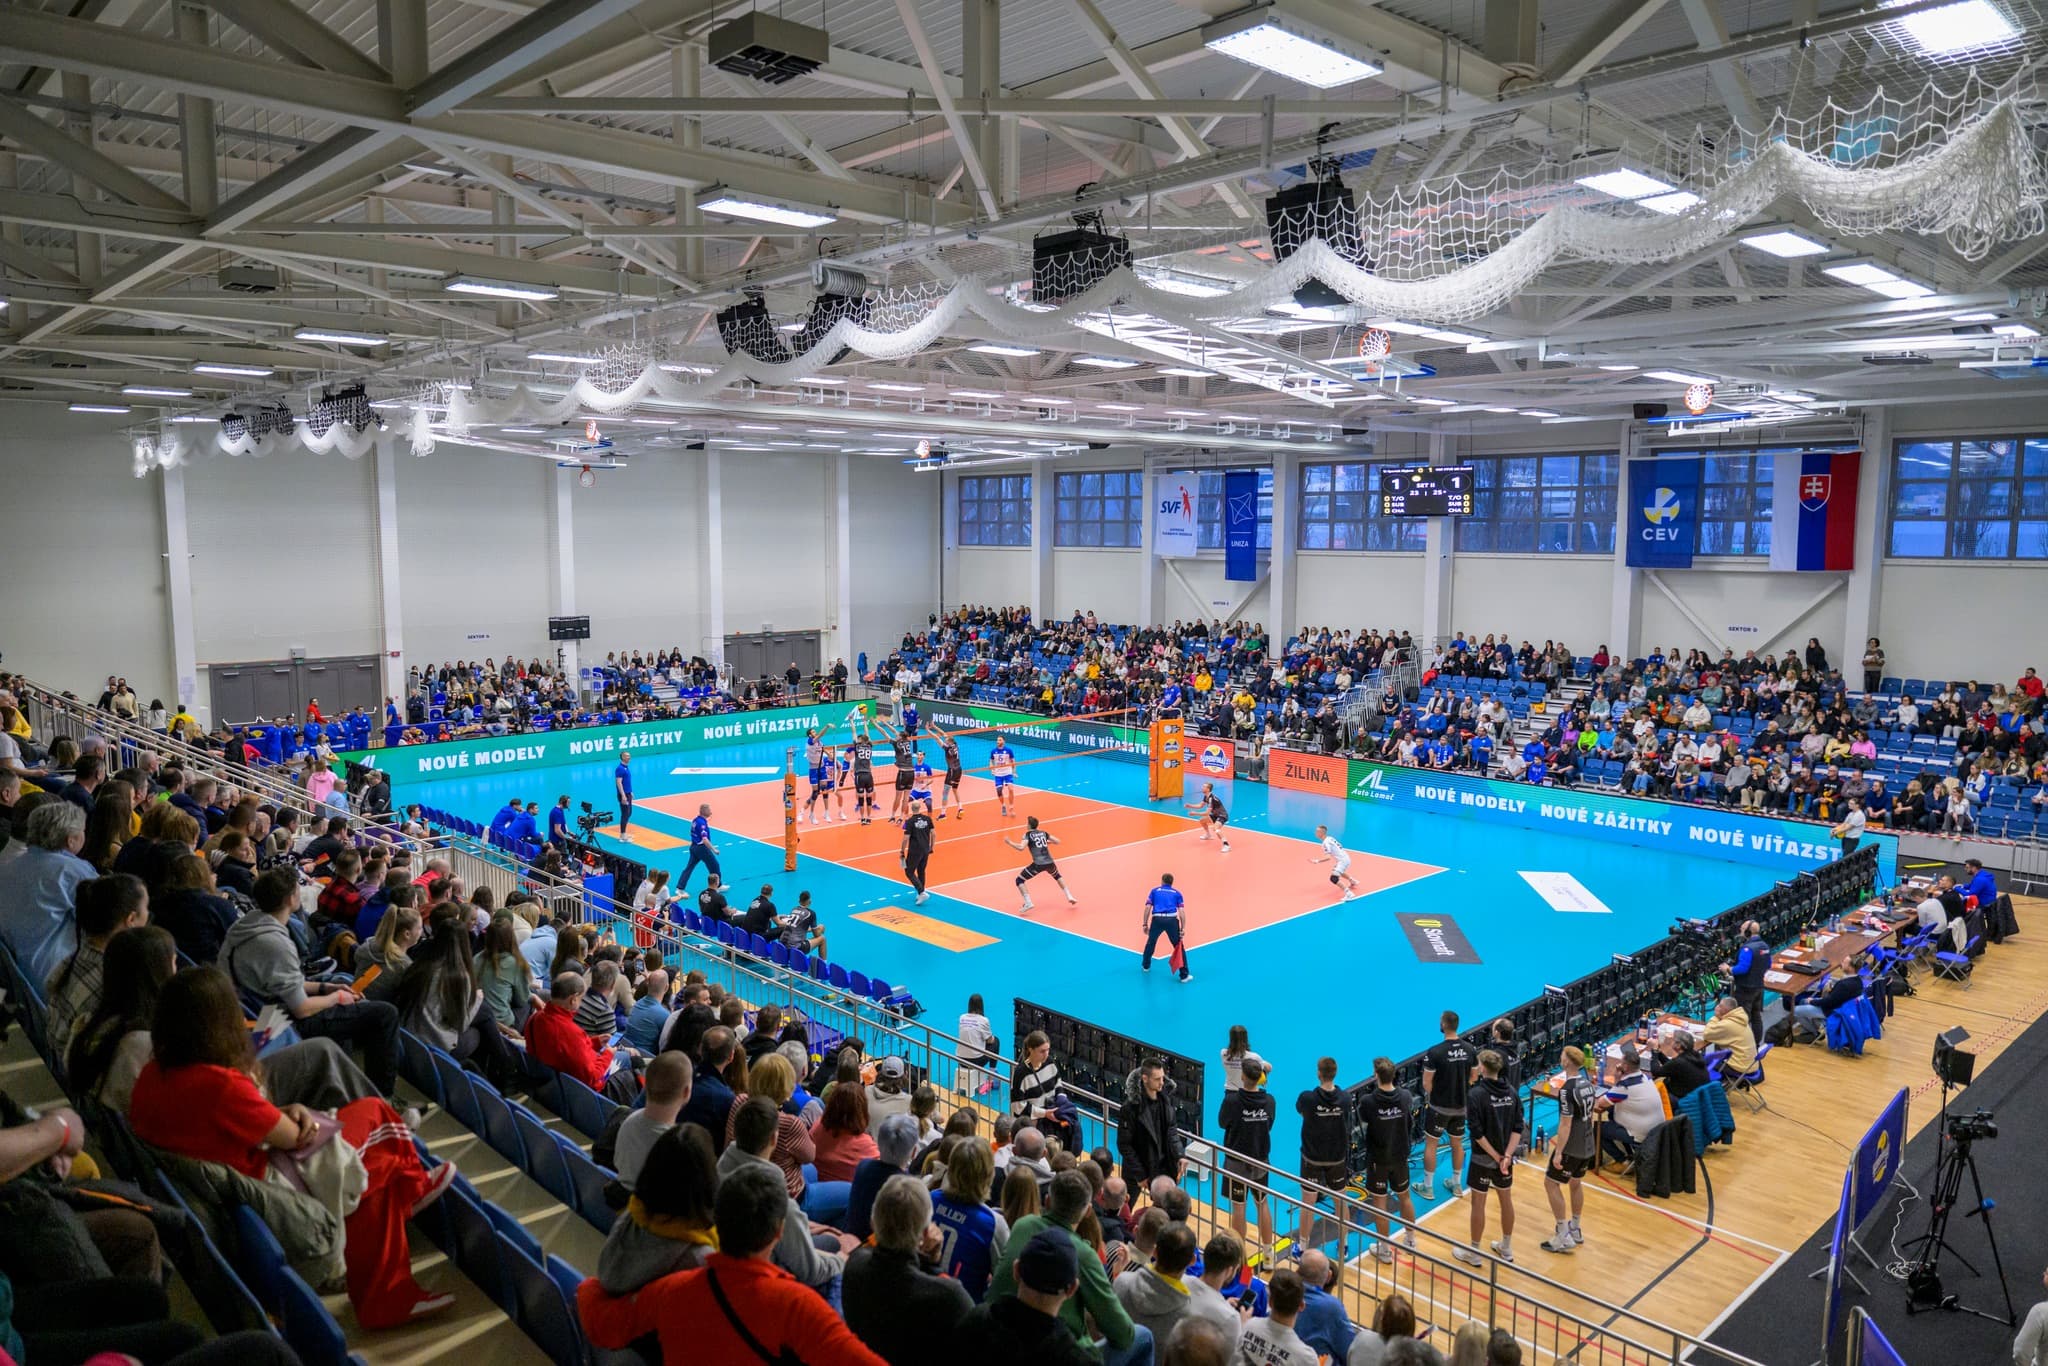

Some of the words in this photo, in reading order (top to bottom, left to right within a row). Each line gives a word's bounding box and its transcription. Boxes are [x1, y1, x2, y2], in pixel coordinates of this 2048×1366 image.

[1391, 478, 1400, 490] 1
[1451, 476, 1460, 489] 1
[1160, 501, 1181, 514] SVF
[1642, 528, 1679, 541] CEV
[704, 722, 742, 740] NOVÉ
[746, 714, 819, 734] VÍŤAZSTVÁ
[932, 713, 955, 725] NOVÉ
[956, 716, 990, 728] MODELY
[1022, 725, 1062, 741] ZÁŽITKY
[1069, 733, 1096, 747] NOVÉ
[570, 736, 614, 755] NOVÉ
[618, 730, 683, 749] ZÁŽITKY
[418, 751, 469, 772] NOVÉ
[474, 745, 546, 765] MODELY
[858, 748, 871, 760] 28
[1285, 761, 1330, 783] ŽILINA
[1351, 788, 1370, 797] Auto
[1415, 785, 1456, 803] NOVÉ
[1461, 791, 1527, 813] MODELY
[1540, 803, 1588, 823] NOVÉ
[1593, 811, 1673, 836] ZÁŽITKY
[1034, 836, 1047, 848] 20
[1689, 825, 1744, 847] NOVÉ
[1751, 834, 1843, 862] VÍŤAZST
[787, 913, 800, 928] 21
[1423, 928, 1455, 955] Slovnaft
[1582, 1095, 1594, 1122] 12
[1270, 1343, 1290, 1361] TKE
